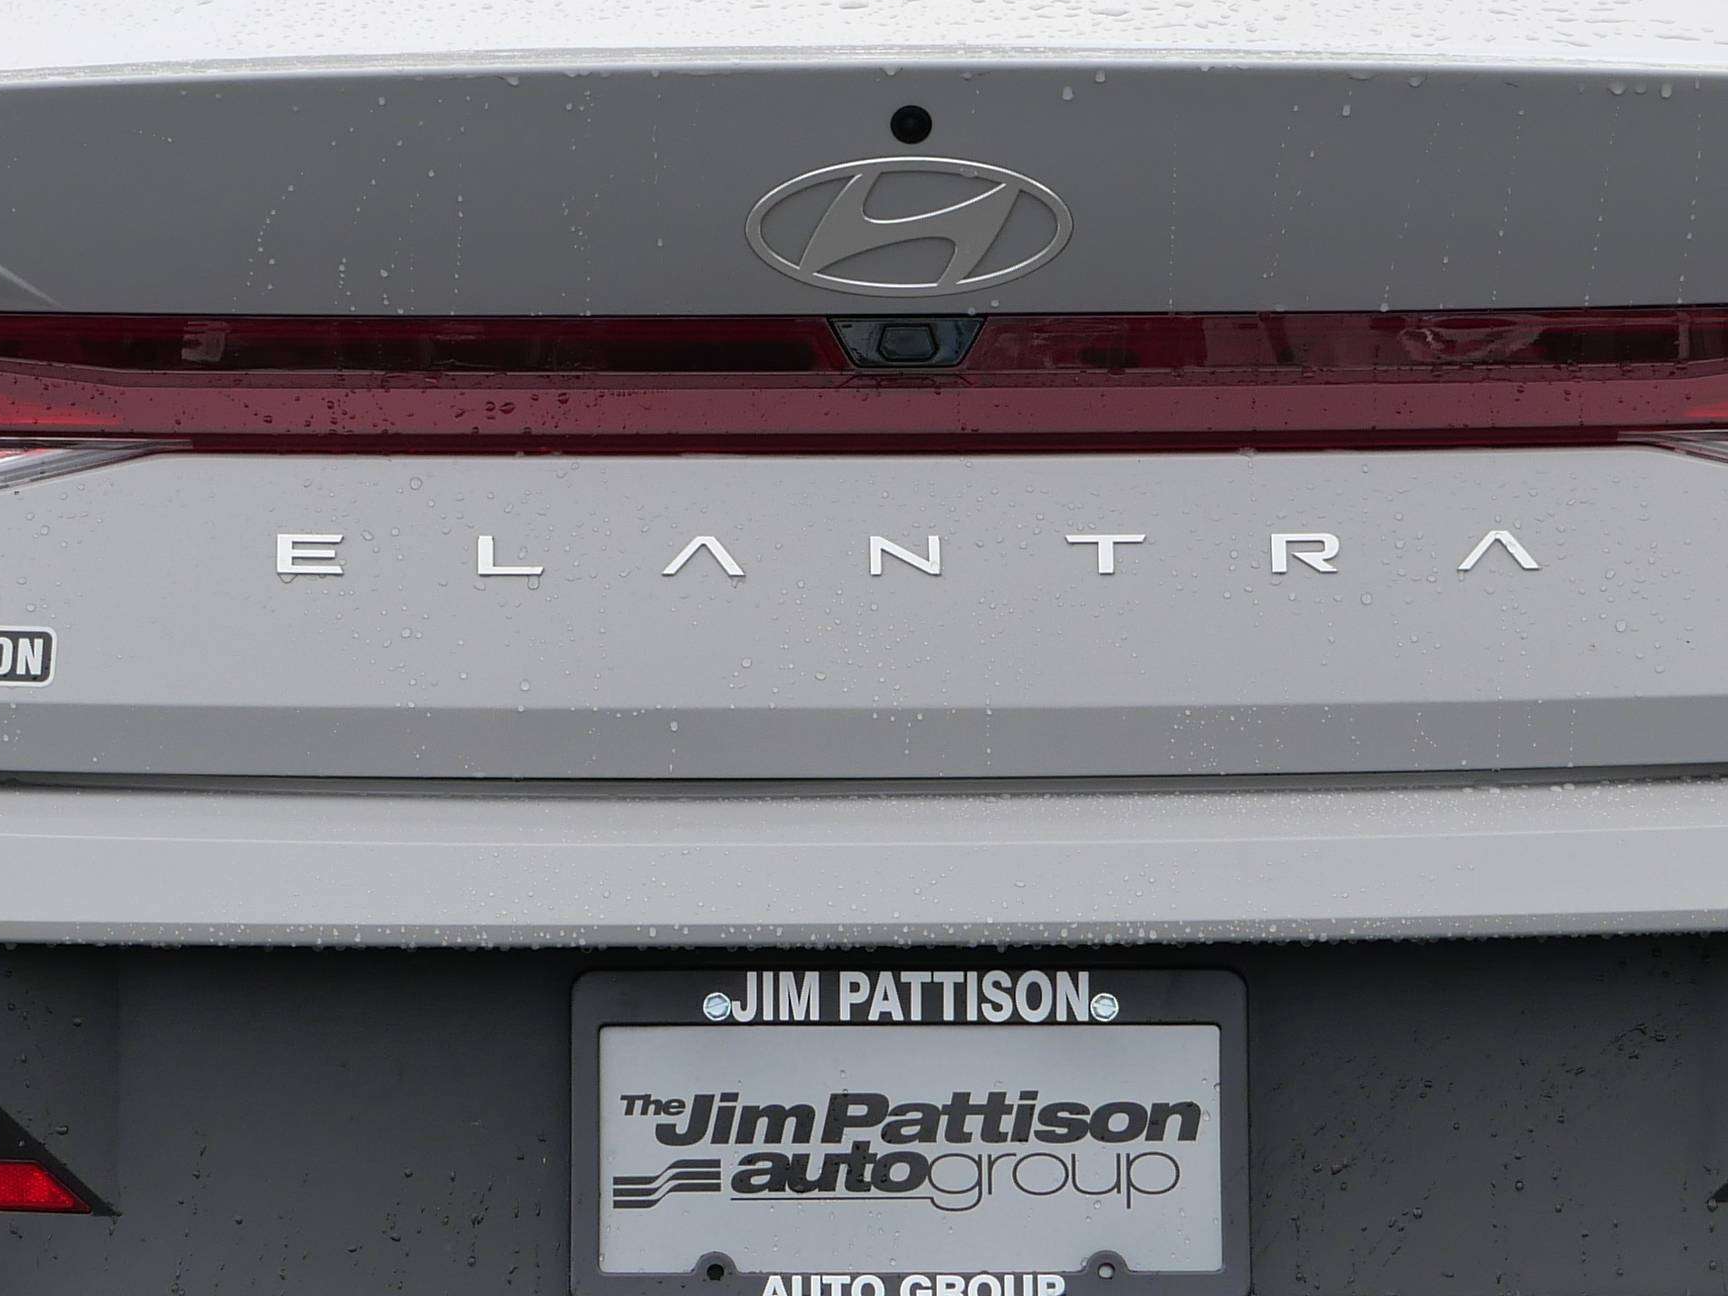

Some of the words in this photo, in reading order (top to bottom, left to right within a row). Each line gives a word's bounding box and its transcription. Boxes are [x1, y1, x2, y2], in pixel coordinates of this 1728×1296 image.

[276, 531, 1541, 576] ELANTRA
[731, 971, 819, 1022] JIM
[839, 970, 1090, 1022] PATTISON
[619, 1093, 686, 1117] The
